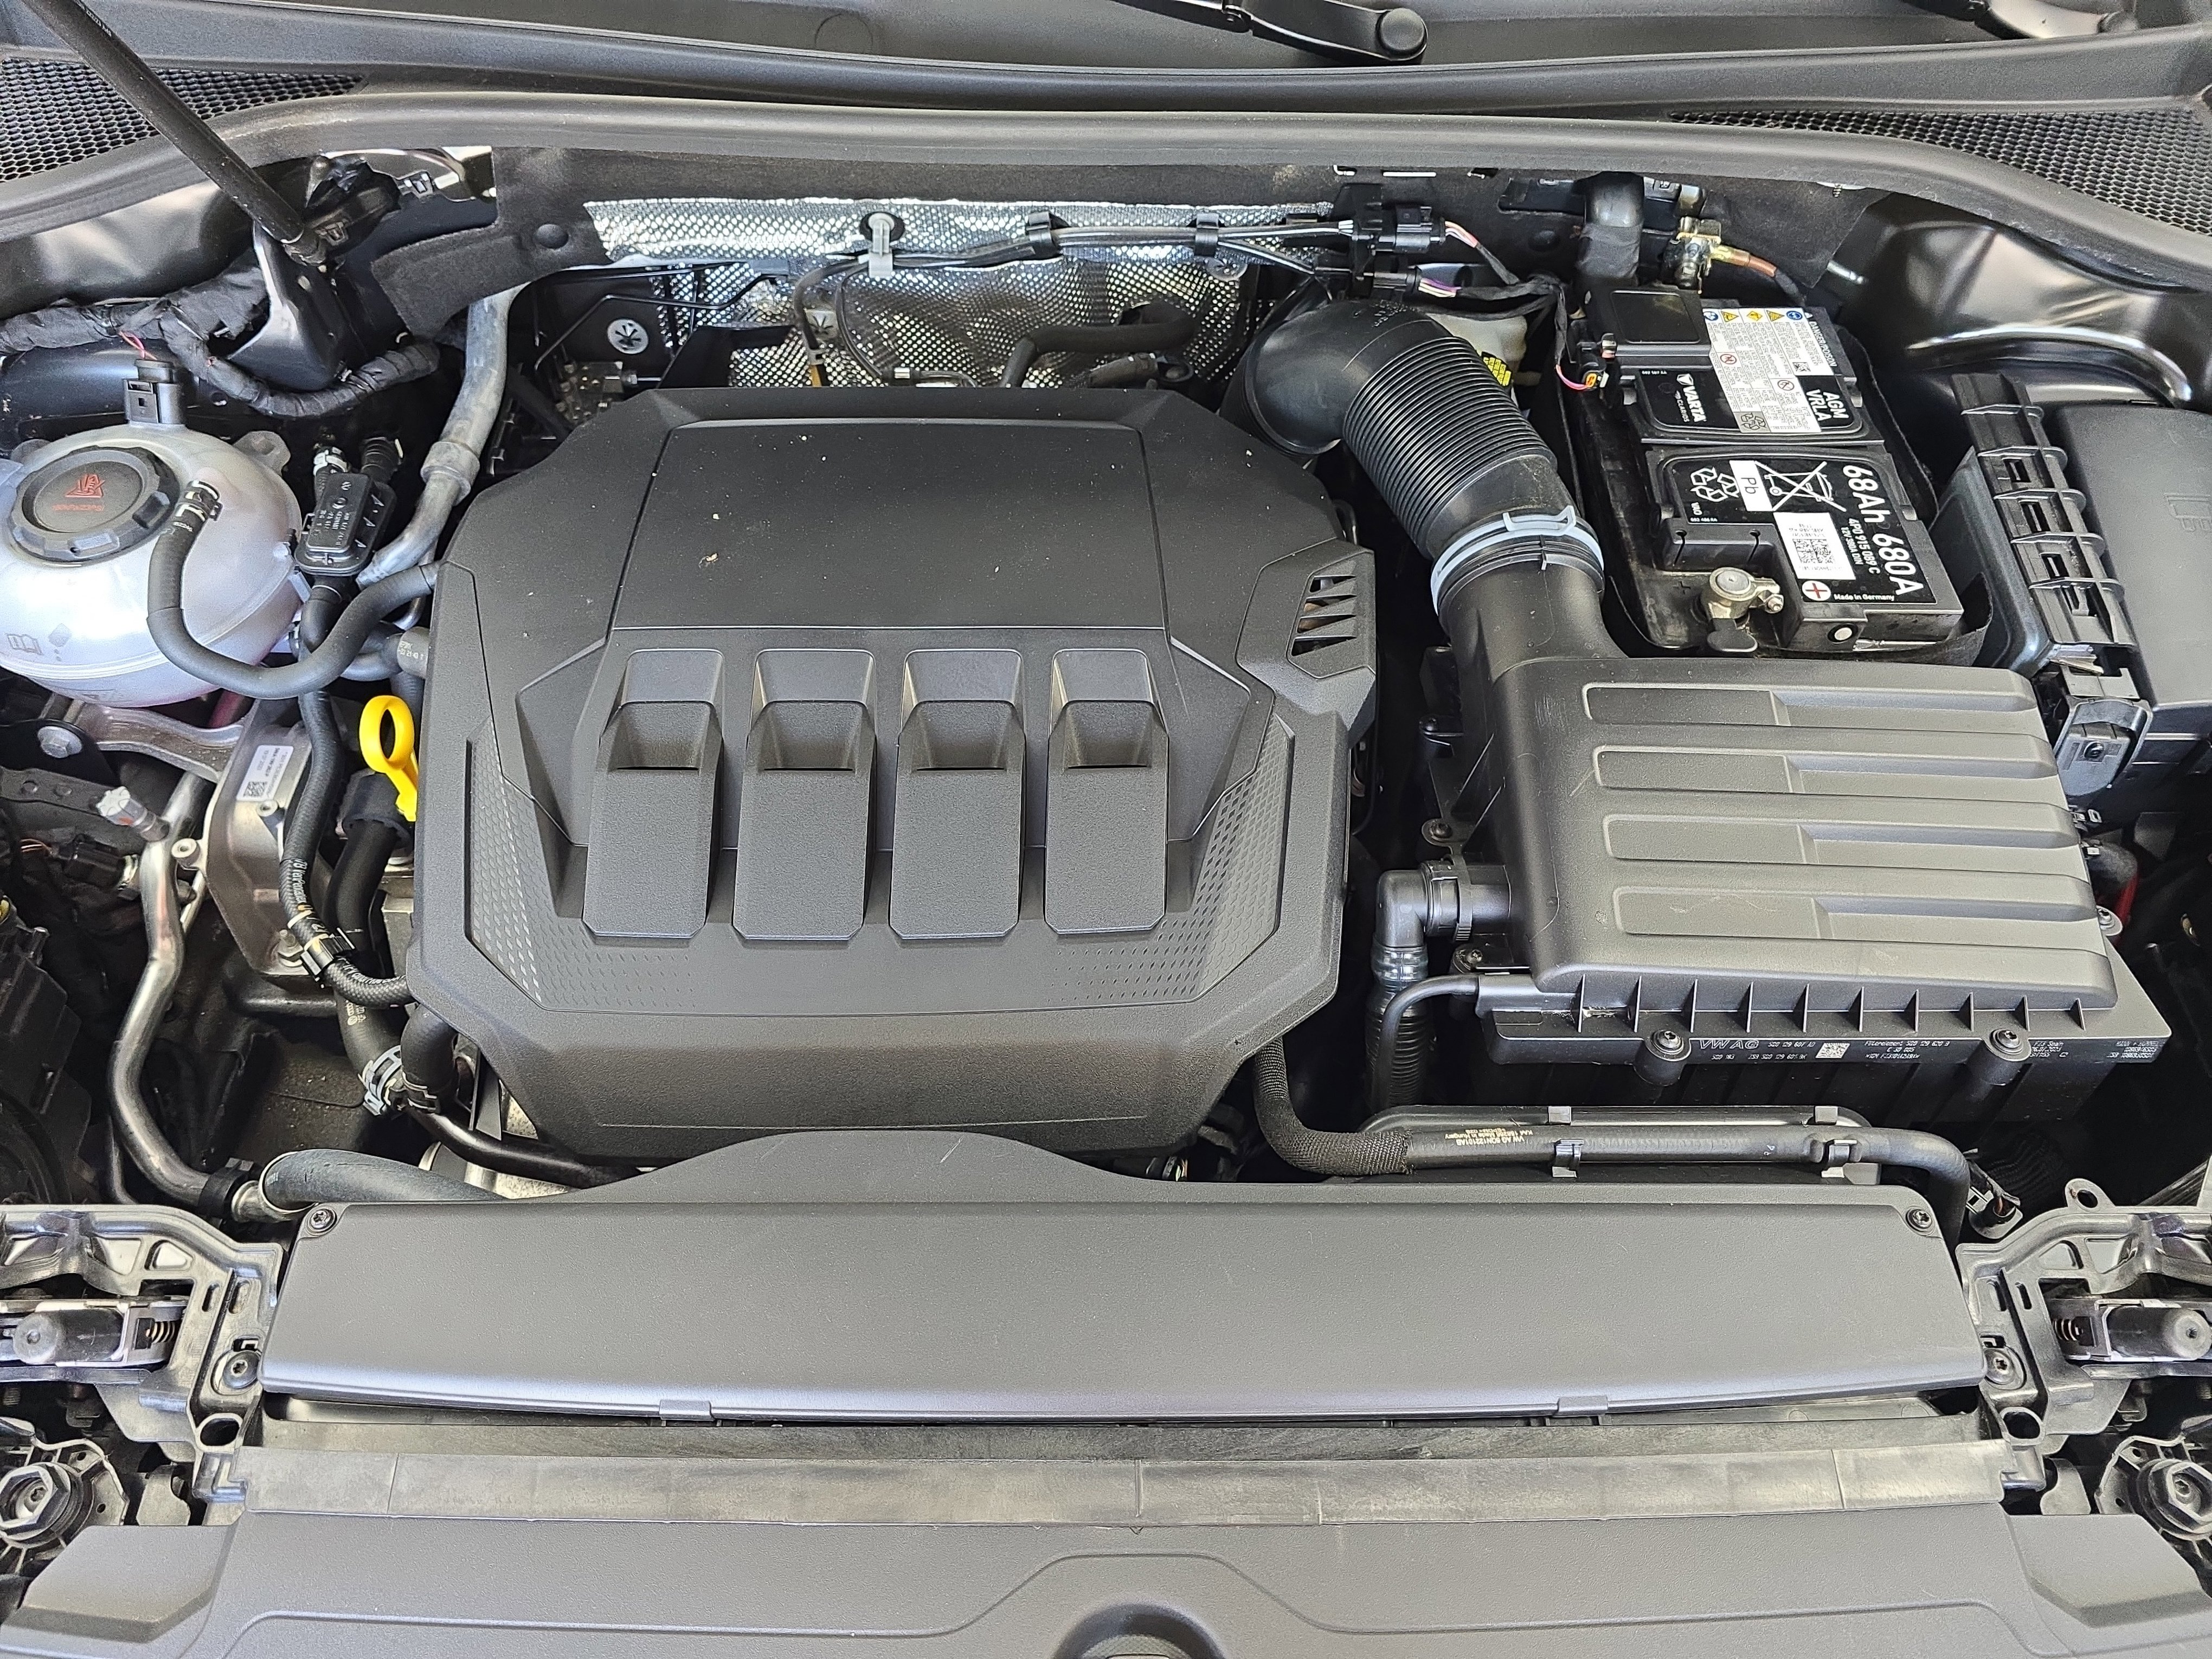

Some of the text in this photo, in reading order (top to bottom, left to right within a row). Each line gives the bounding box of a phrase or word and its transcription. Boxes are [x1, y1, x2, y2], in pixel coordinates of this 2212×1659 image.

[1809, 321, 1837, 366] DANGER/POISON
[1683, 385, 1706, 422] VARTA
[1806, 389, 1832, 421] VRLA
[1823, 391, 1849, 419] AGM
[1741, 477, 1759, 494] Pb
[1843, 465, 1924, 596] 68Ah 680A
[1849, 518, 1864, 534] 4P0
[1841, 527, 1852, 537] 12V
[1852, 554, 1863, 565] DIN
[1855, 535, 1870, 550] 915
[1862, 551, 1877, 566] 089
[1700, 1040, 1759, 1049] VW AG
